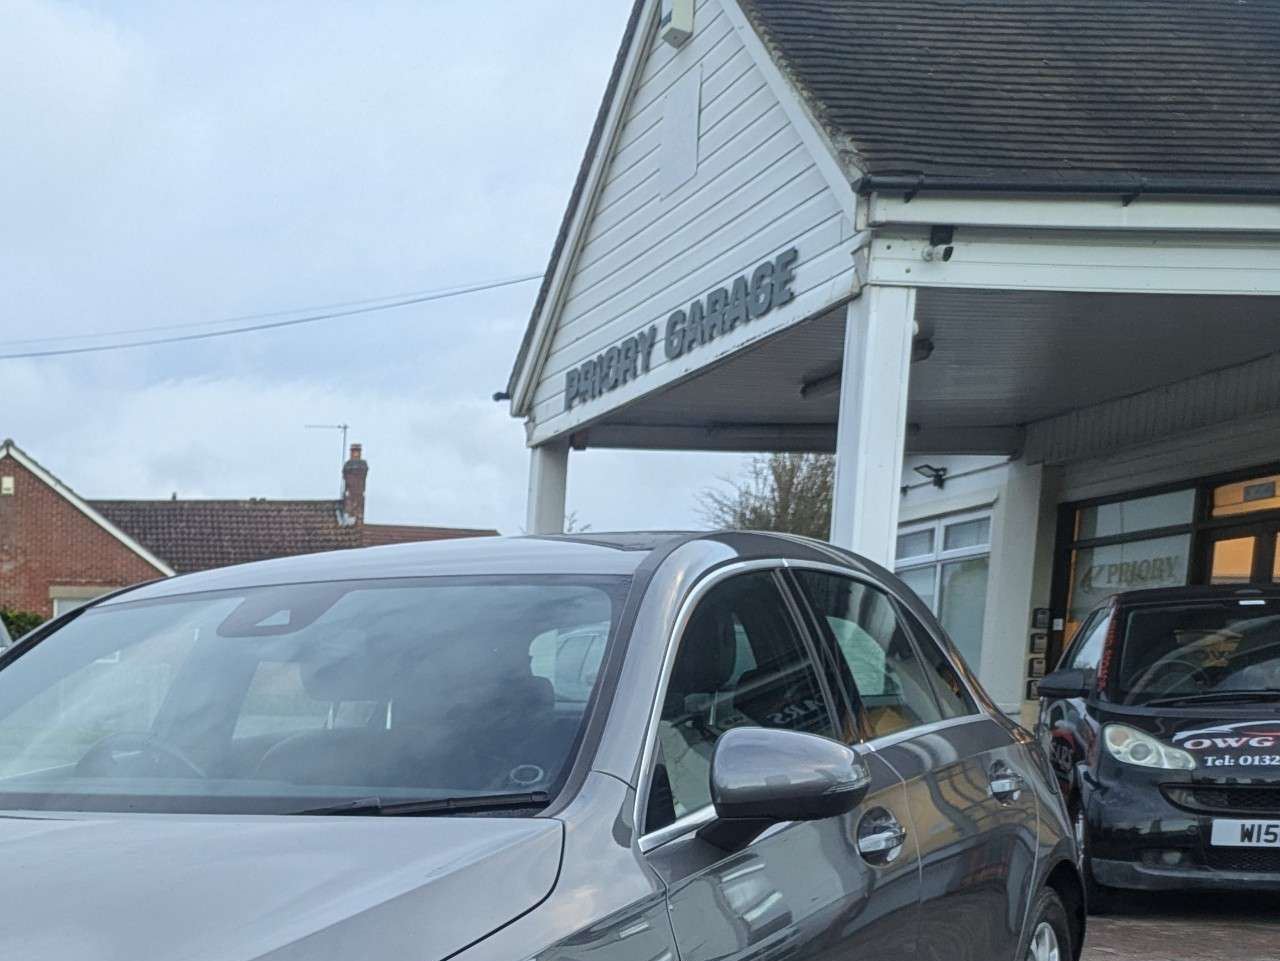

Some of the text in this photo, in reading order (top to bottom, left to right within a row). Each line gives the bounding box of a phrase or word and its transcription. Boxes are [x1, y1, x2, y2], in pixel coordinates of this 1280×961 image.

[564, 245, 798, 411] PRIORY GARAGE
[1183, 736, 1275, 750] OWG
[1204, 755, 1235, 767] Tel:
